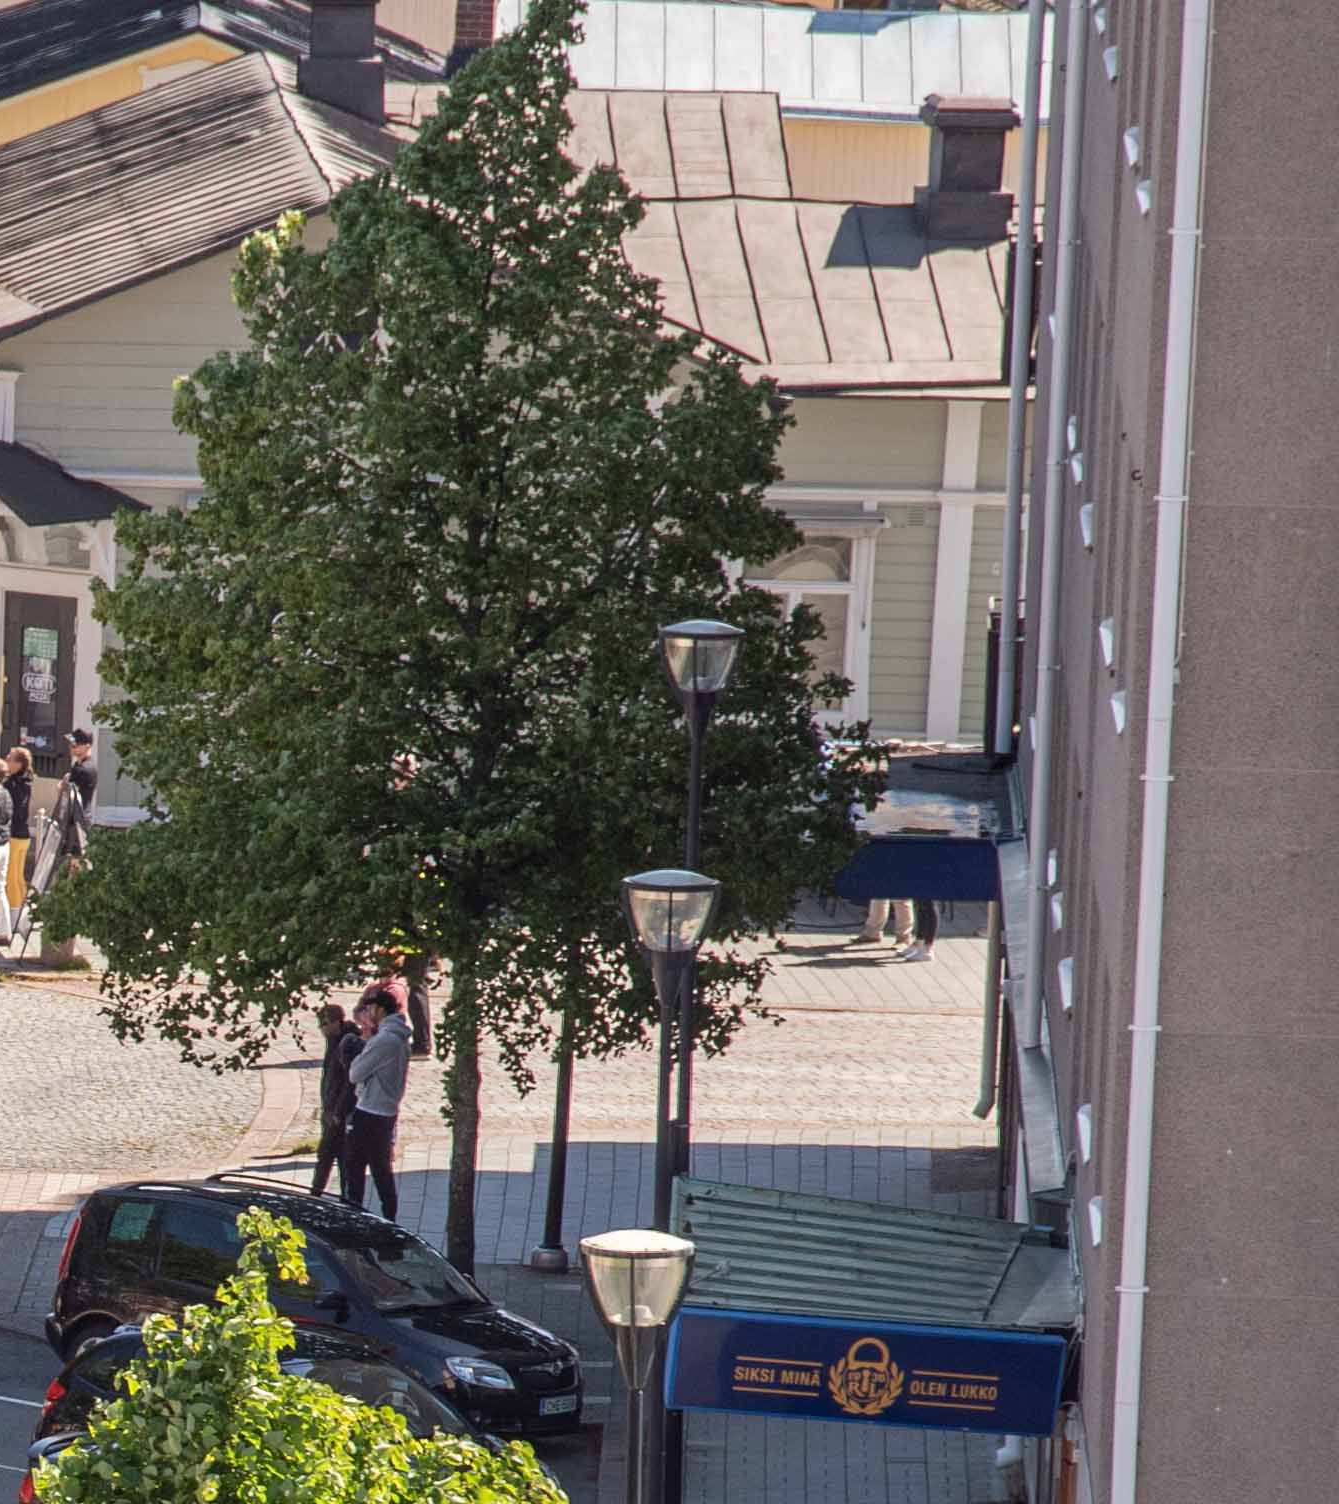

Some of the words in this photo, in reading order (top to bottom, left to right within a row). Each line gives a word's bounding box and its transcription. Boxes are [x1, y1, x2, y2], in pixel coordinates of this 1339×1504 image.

[734, 1365, 775, 1384] SIKSI
[781, 1365, 821, 1387] MINÄ
[910, 1381, 946, 1398] OLEN
[950, 1382, 998, 1402] LUKKO
